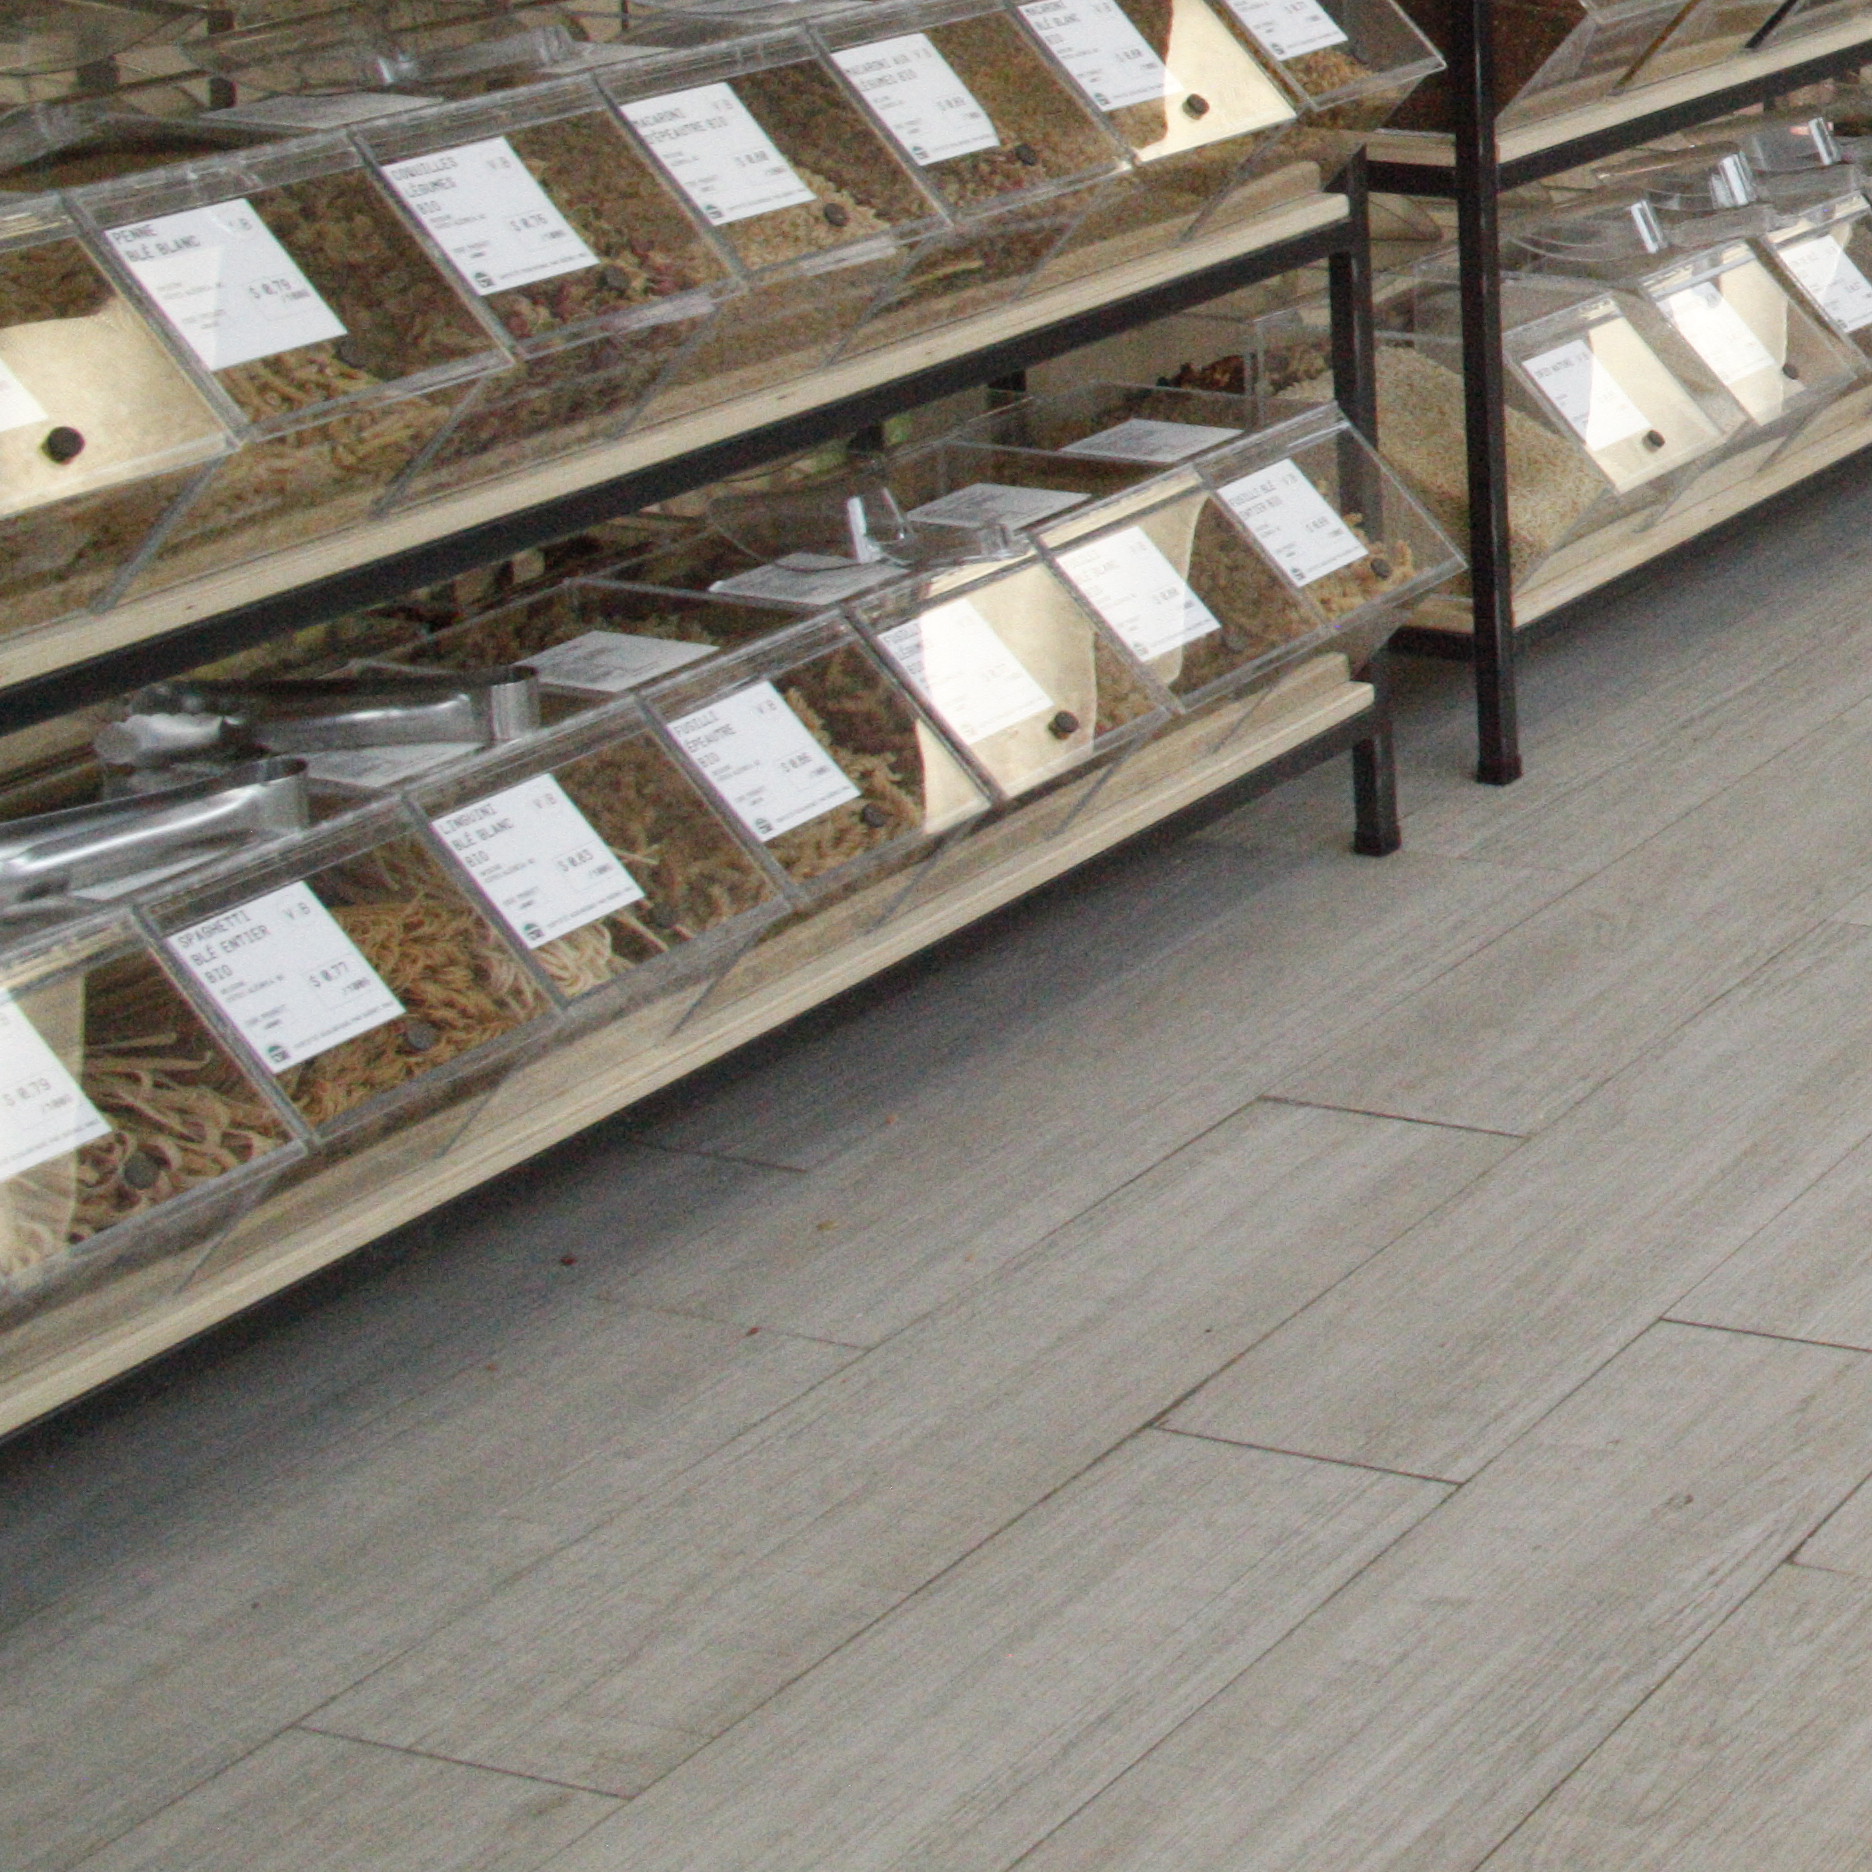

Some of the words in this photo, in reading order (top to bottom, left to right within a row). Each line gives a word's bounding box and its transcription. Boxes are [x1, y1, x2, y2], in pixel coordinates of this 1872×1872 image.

[111, 224, 158, 244] PENNE
[125, 244, 155, 263] BLÉ
[155, 235, 201, 257] BLANC
[440, 802, 498, 836] LINGUINI
[451, 830, 478, 852] BLÉ
[475, 817, 515, 842] BLANC
[464, 849, 491, 868] BIO
[176, 909, 252, 950] SPAGHETTI
[190, 943, 218, 967] BLÉ
[220, 924, 272, 955] ENTIER
[203, 963, 234, 985] BIO
[308, 973, 322, 988] $
[321, 960, 350, 983] 0.77
